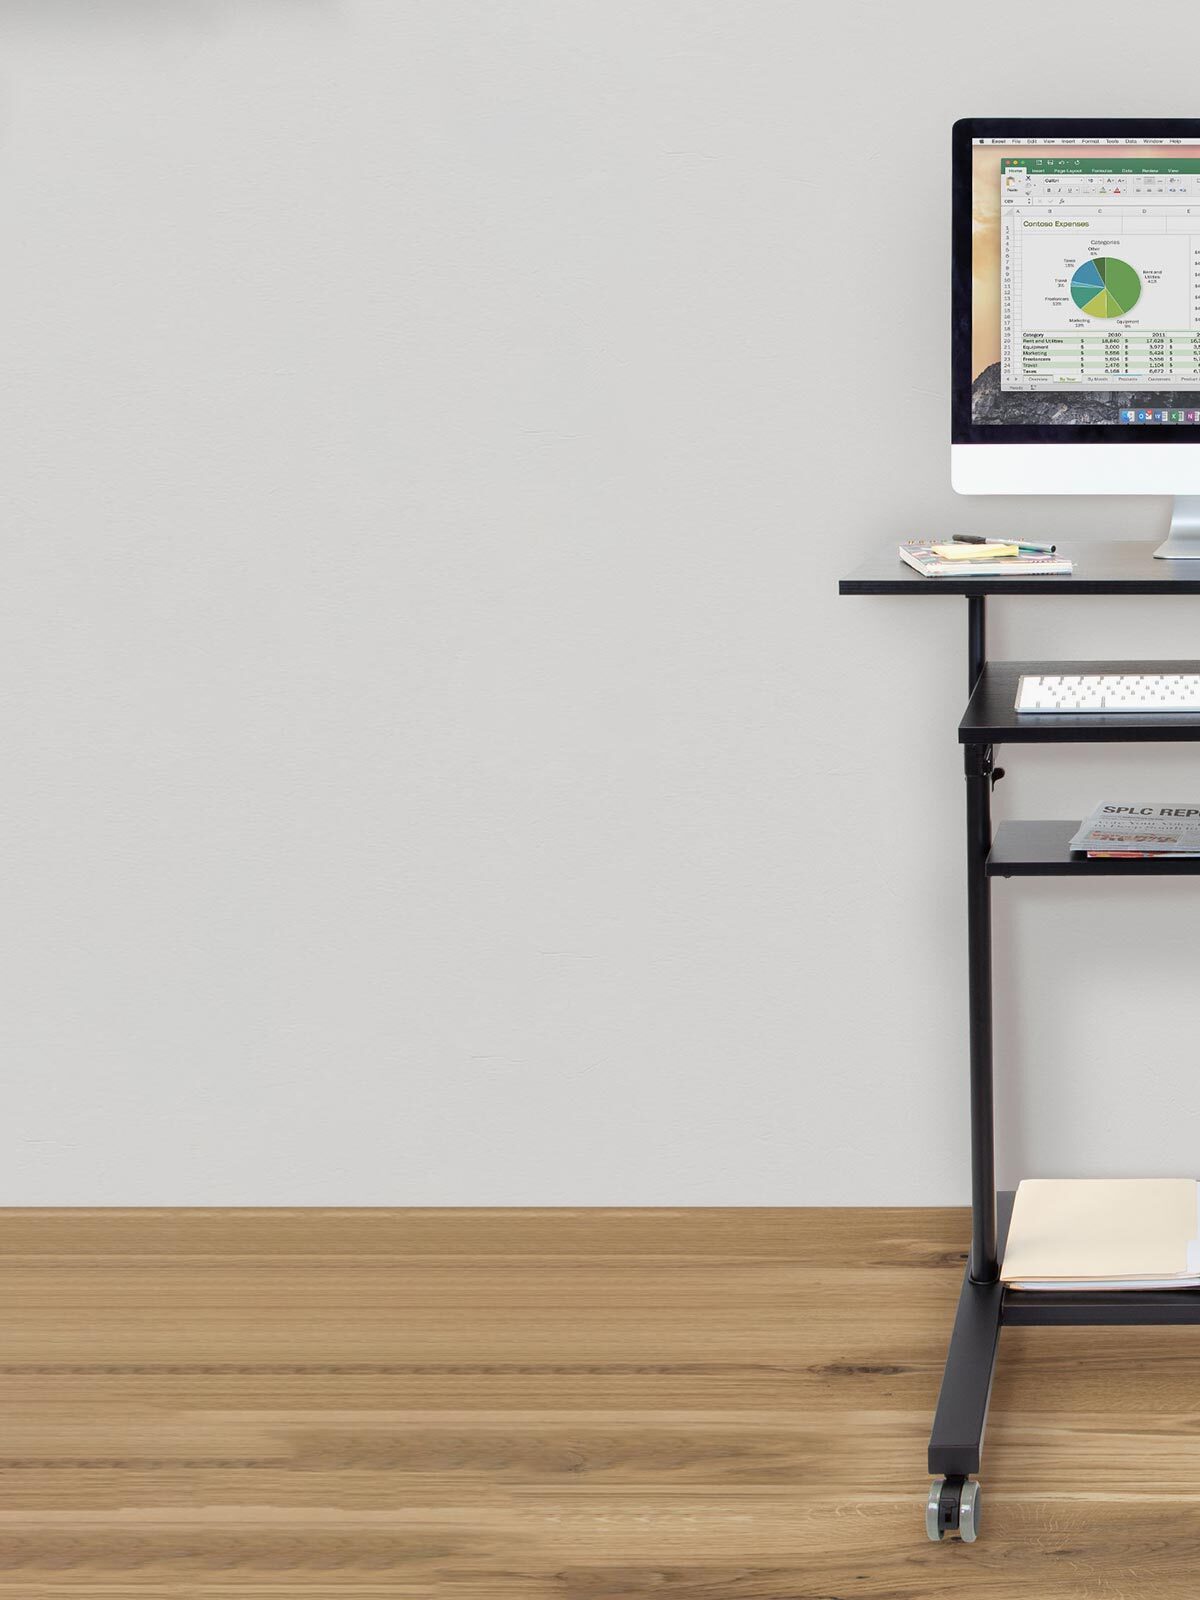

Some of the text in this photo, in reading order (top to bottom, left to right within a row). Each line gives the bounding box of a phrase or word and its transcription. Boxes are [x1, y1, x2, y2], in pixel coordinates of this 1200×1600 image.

[1023, 220, 1089, 229] Contoso Expenses
[1103, 805, 1154, 816] SPLC
